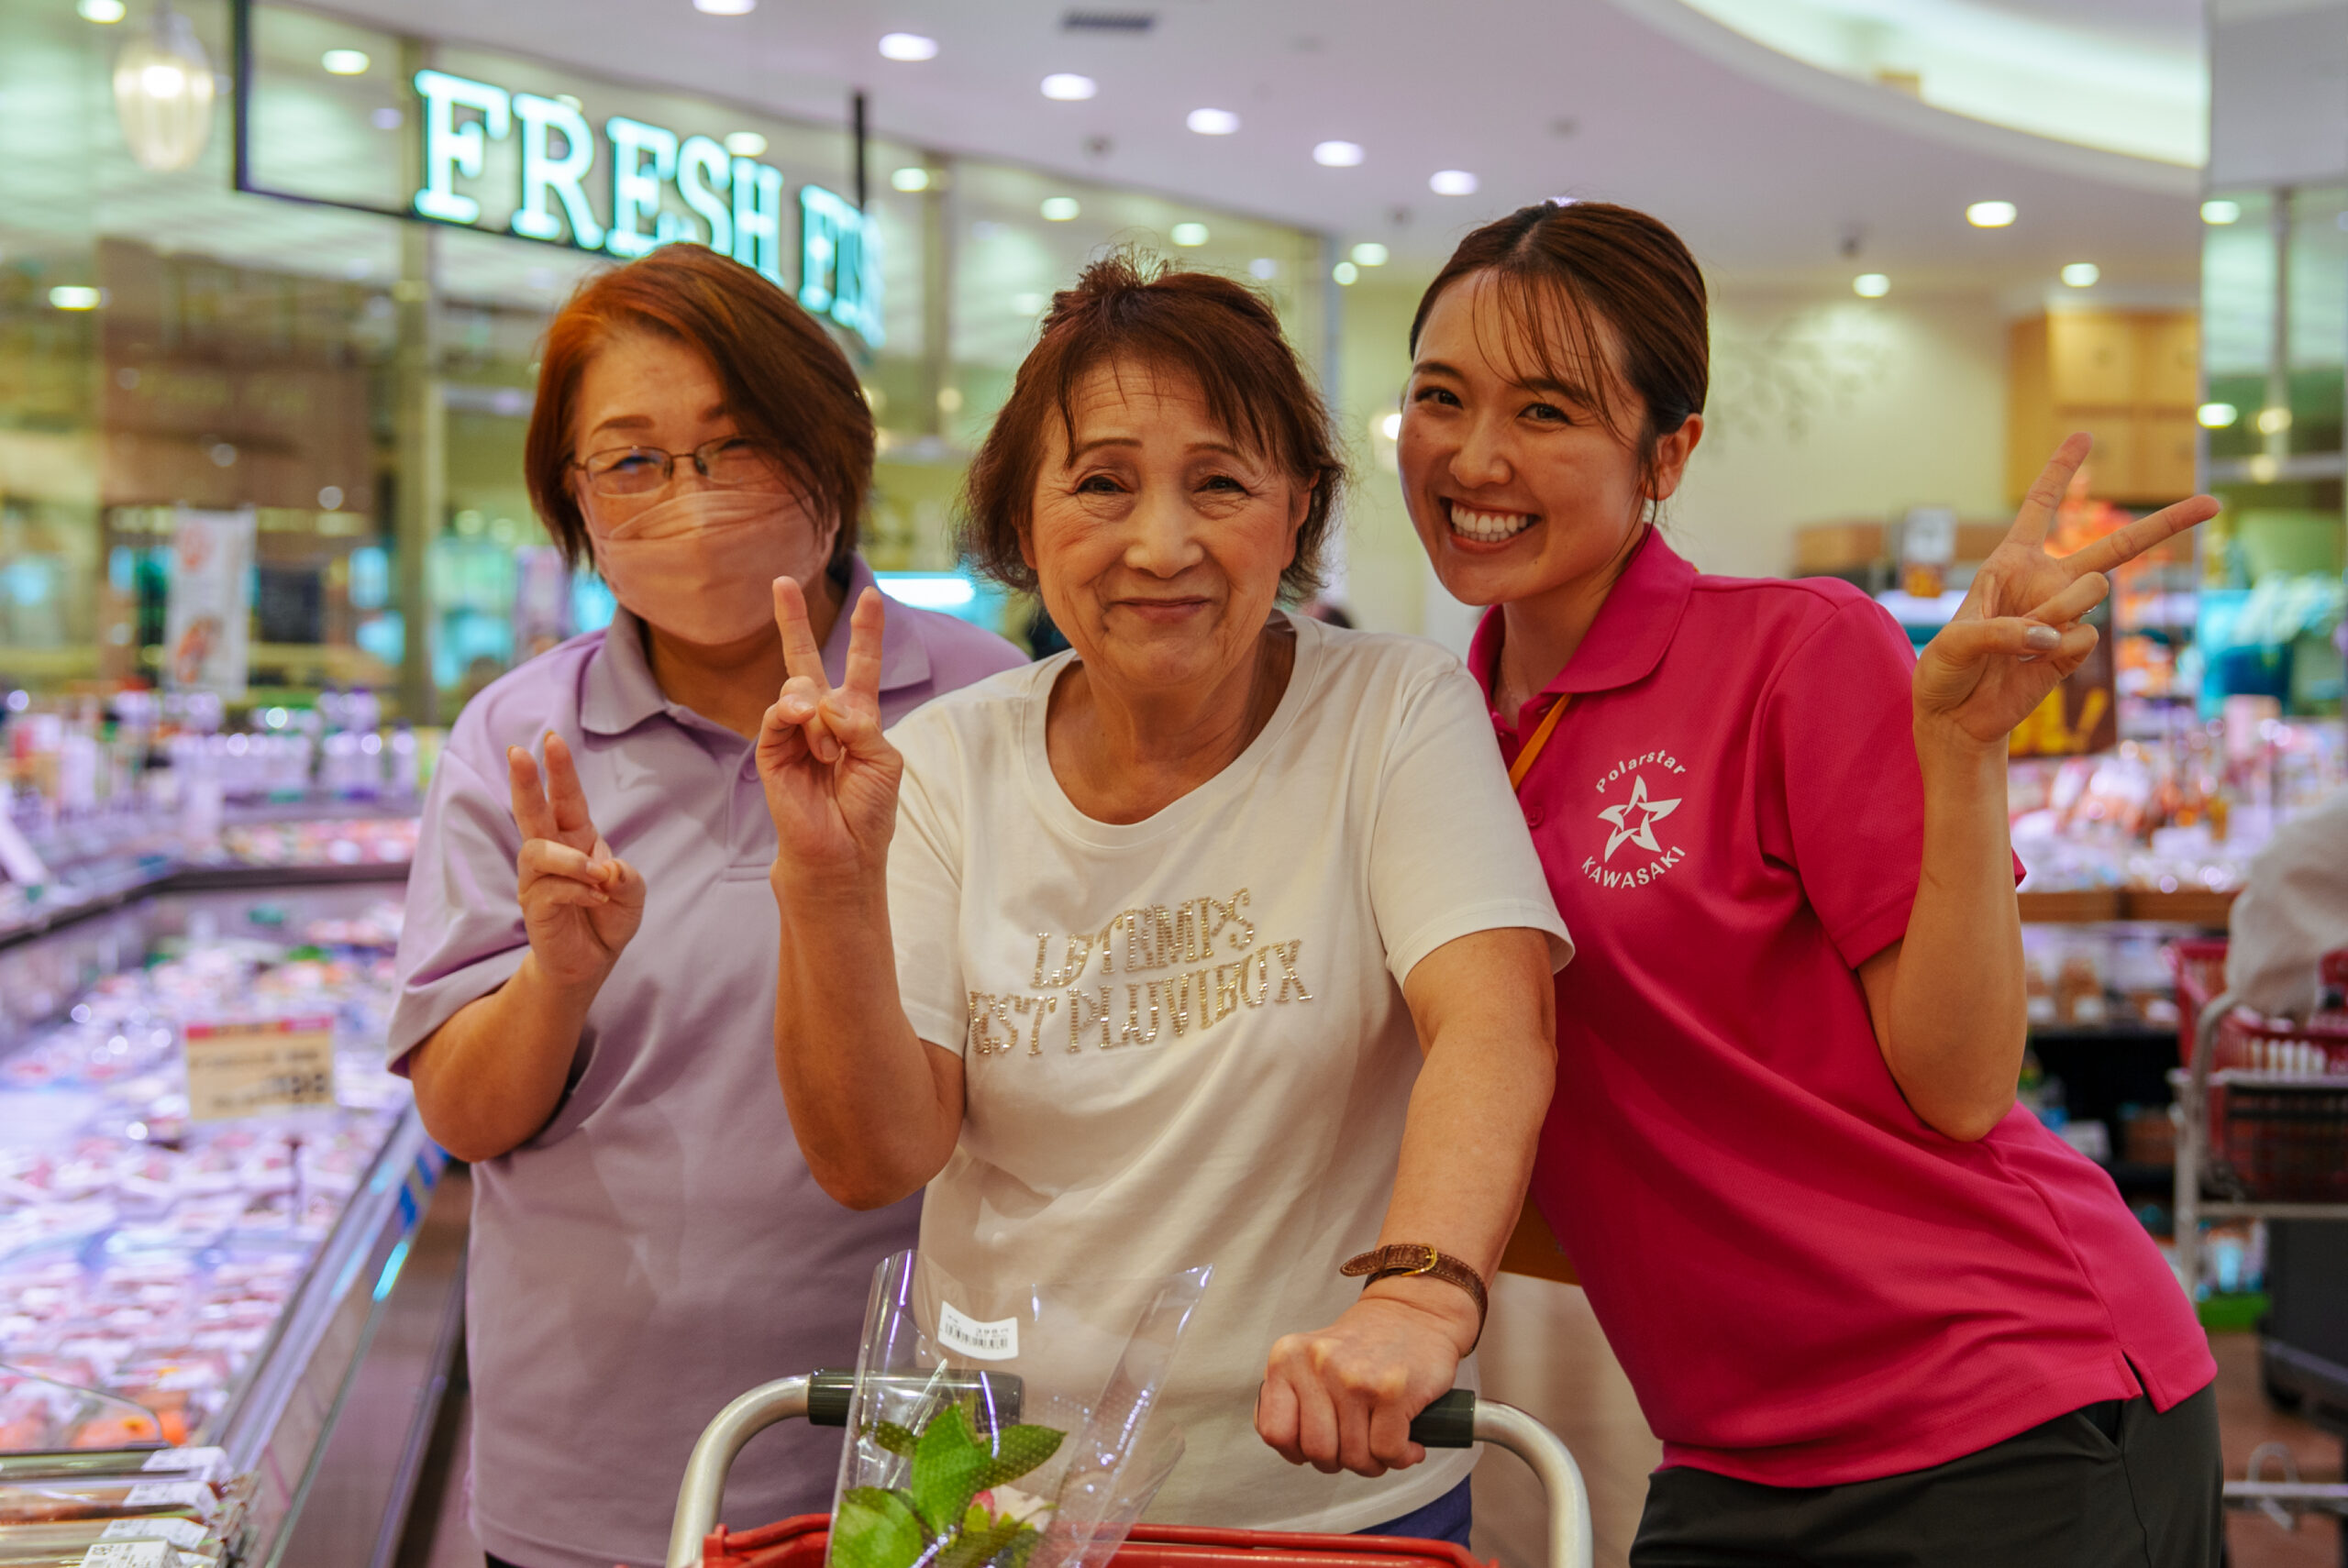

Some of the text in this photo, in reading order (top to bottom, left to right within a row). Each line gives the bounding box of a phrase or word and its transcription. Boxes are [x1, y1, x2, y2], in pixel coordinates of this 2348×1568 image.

[414, 69, 785, 287] FRESH
[1596, 749, 1686, 793] Polarstar
[1581, 845, 1686, 889] KAWASAKI
[1028, 888, 1255, 989] LE TEMPS
[969, 939, 1313, 1057] EST PLUVIEUX
